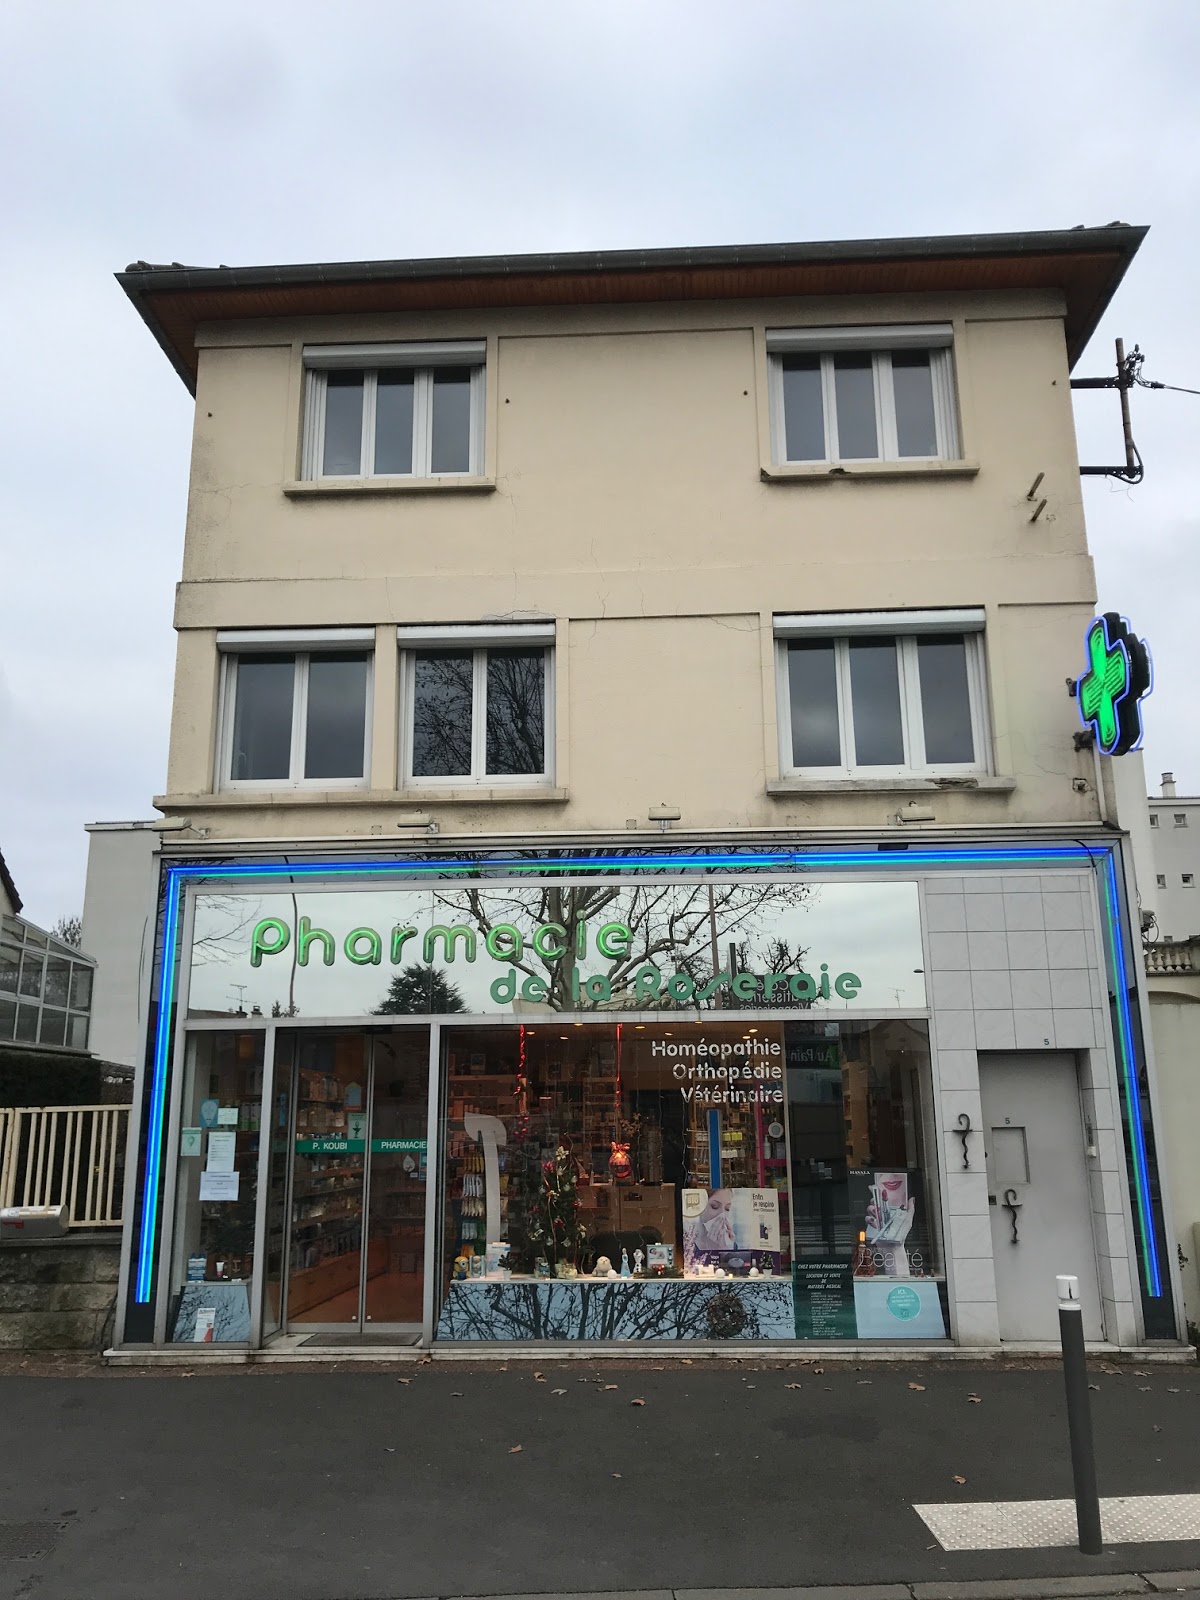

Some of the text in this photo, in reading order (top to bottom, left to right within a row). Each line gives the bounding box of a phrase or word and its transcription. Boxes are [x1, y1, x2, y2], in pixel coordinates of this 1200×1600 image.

[250, 909, 634, 968] Pharmacie
[490, 963, 862, 1004] de la Roseraie
[652, 1039, 781, 1060] Homéopathie
[1043, 1038, 1050, 1046] 5
[673, 1061, 782, 1083] Orthopédie
[681, 1085, 784, 1104] Vétérinaire
[1005, 1117, 1011, 1125] 5
[312, 1142, 320, 1150] P.
[323, 1142, 348, 1150] KOUBI
